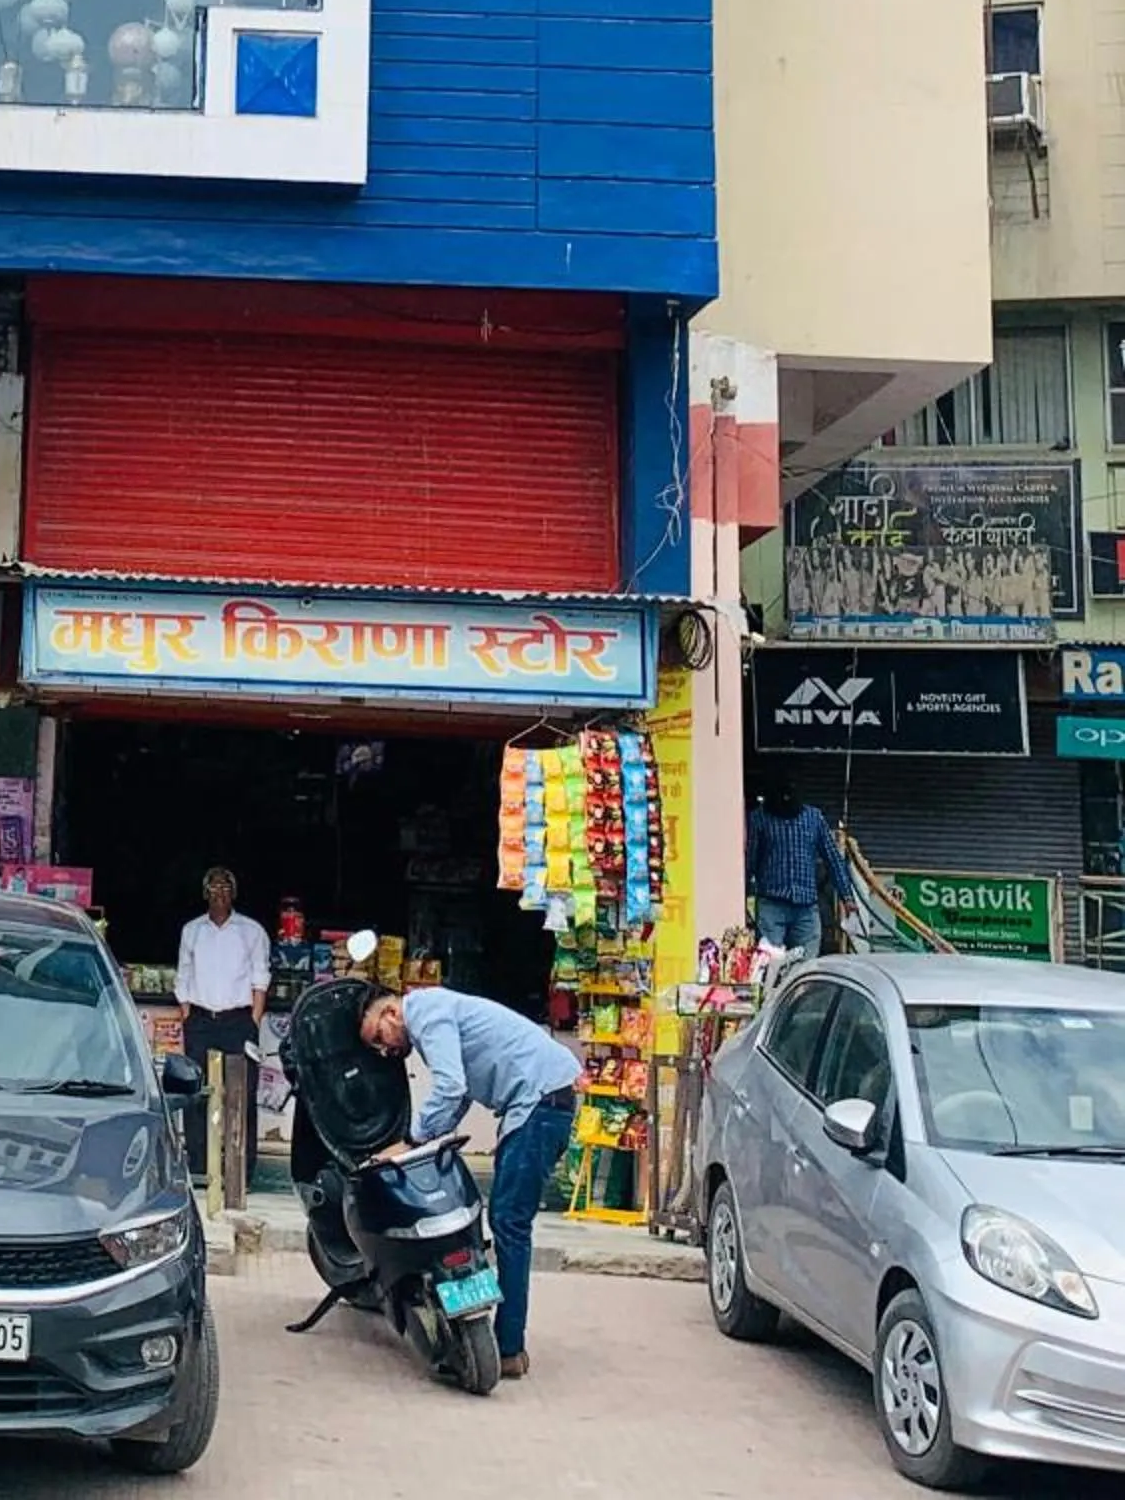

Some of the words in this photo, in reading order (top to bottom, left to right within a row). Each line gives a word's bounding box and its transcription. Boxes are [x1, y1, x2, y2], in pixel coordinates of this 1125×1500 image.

[51, 608, 206, 672] मधुर
[221, 598, 451, 668] किराणा
[469, 613, 618, 681] स्टोर
[775, 708, 882, 726] NIVIA
[918, 879, 1033, 912] Saatvik
